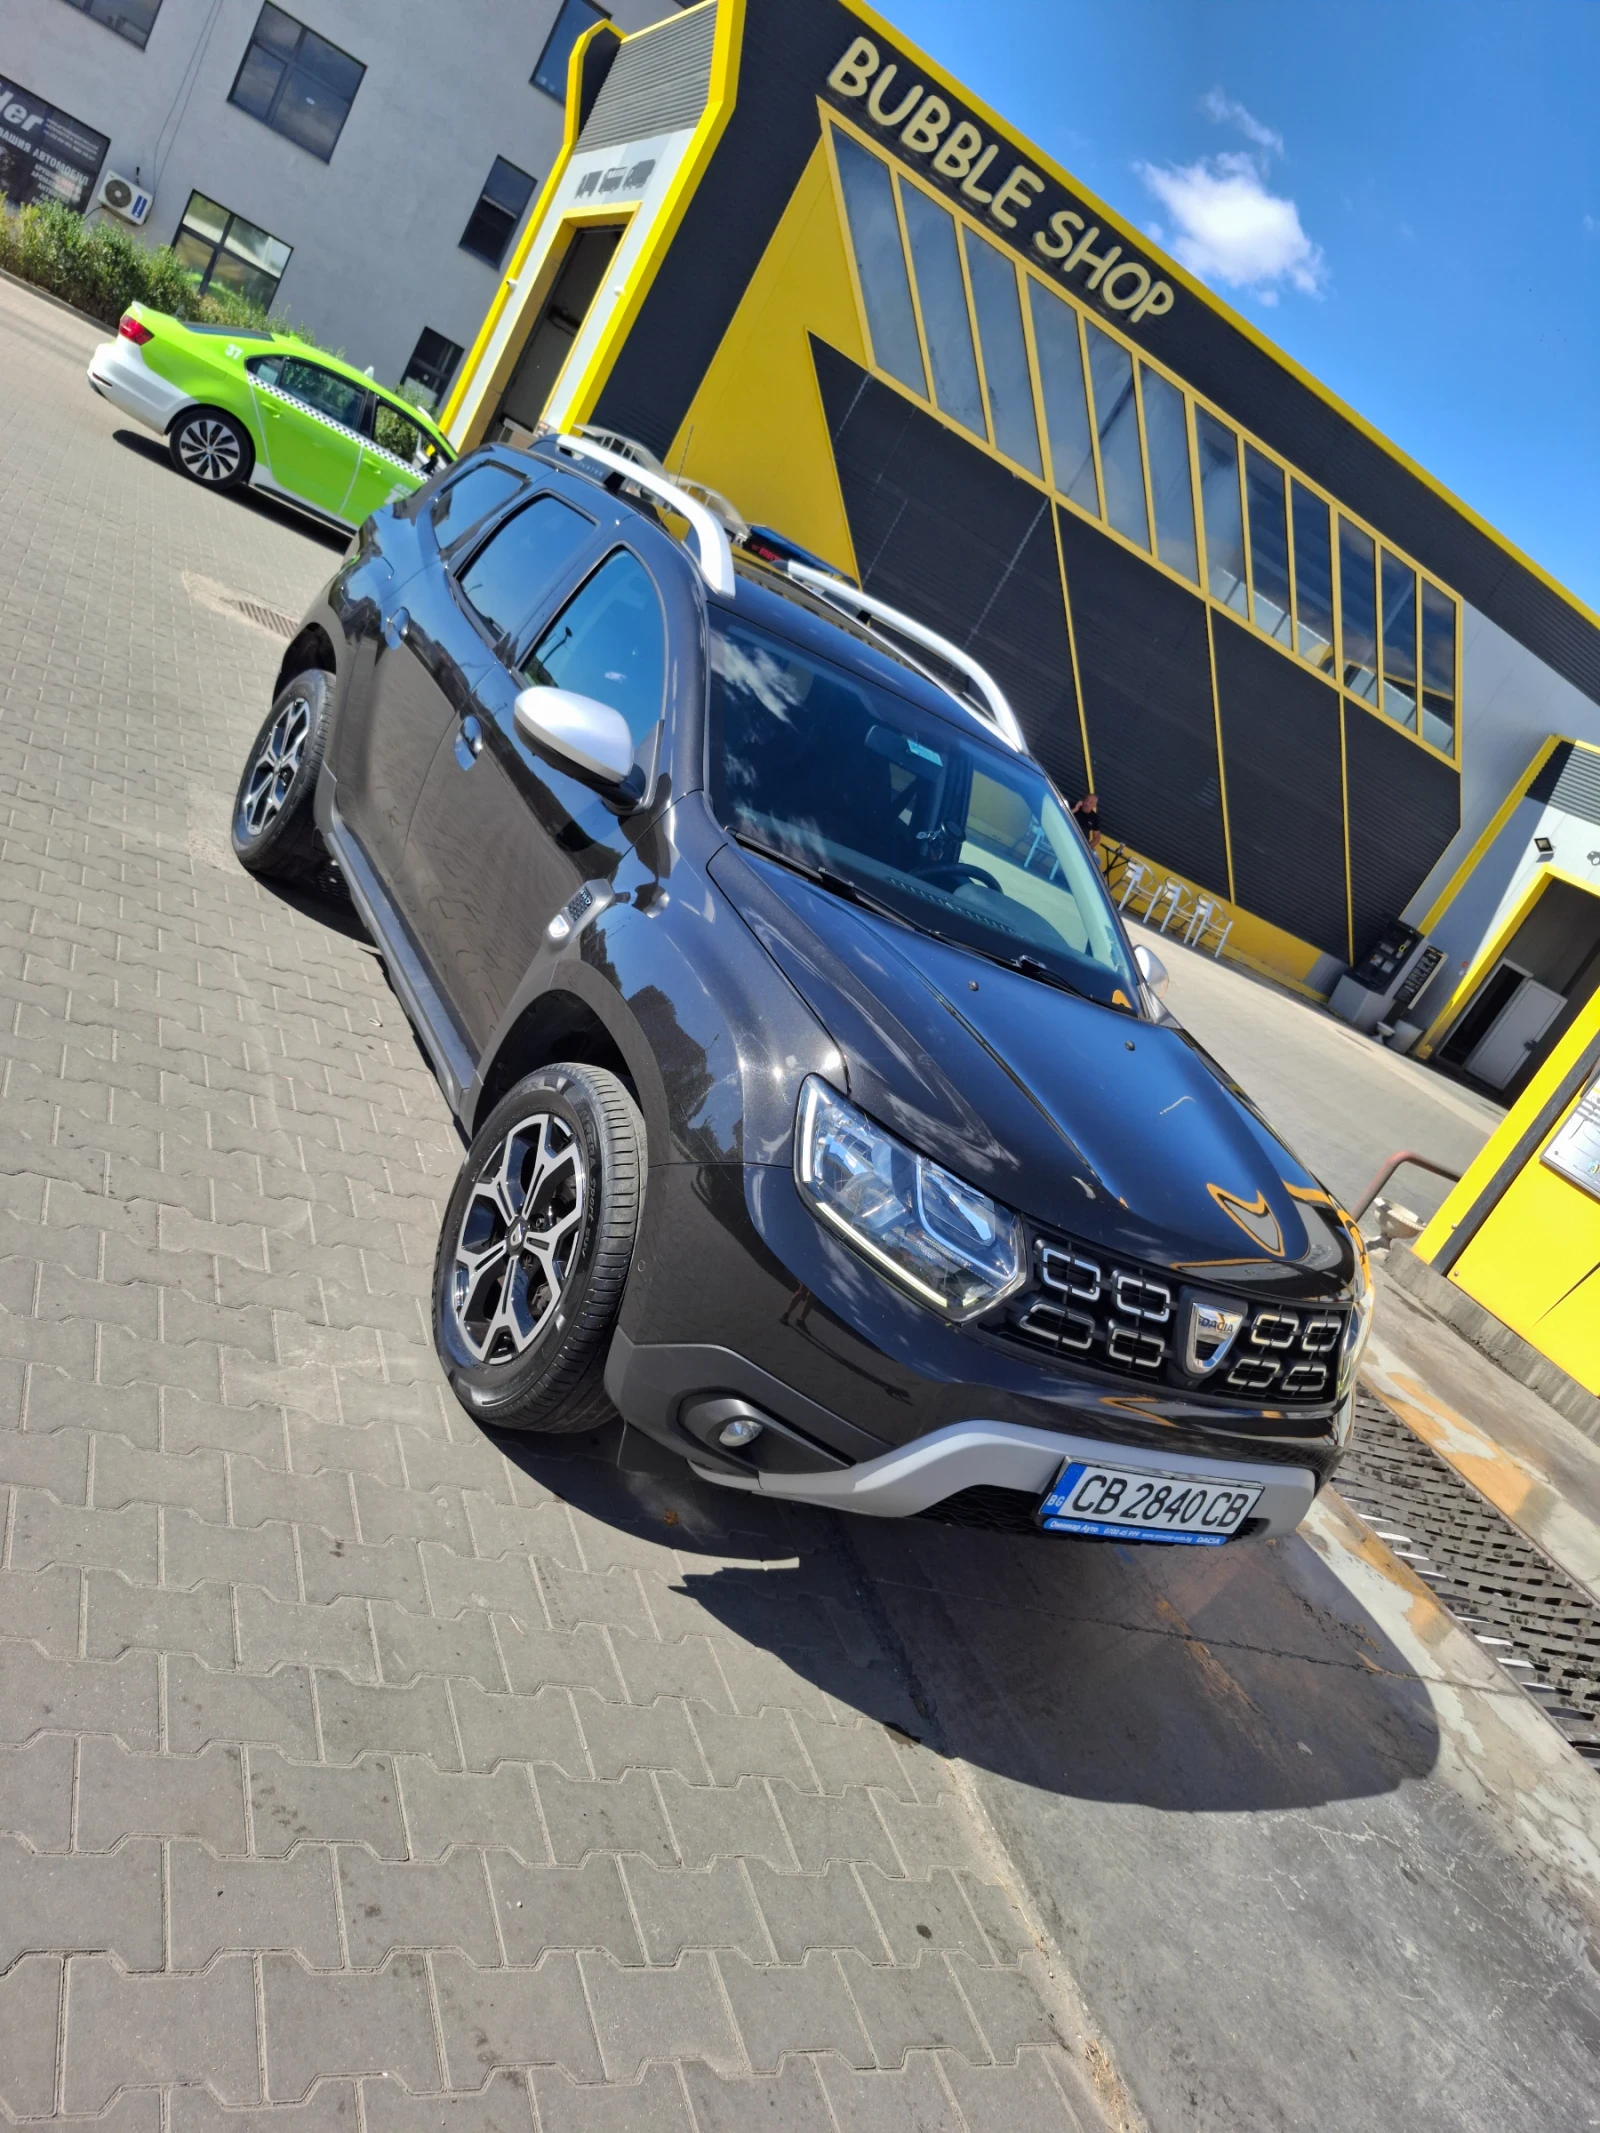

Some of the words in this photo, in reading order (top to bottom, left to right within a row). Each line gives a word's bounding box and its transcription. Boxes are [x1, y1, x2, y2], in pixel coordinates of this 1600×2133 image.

[826, 35, 1045, 229] BUBBLE
[1033, 210, 1175, 323] SHOP
[224, 343, 244, 360] 37
[1200, 1317, 1234, 1333] DACIA
[1046, 1494, 1066, 1507] BG
[1196, 1536, 1221, 1545] DACIA
